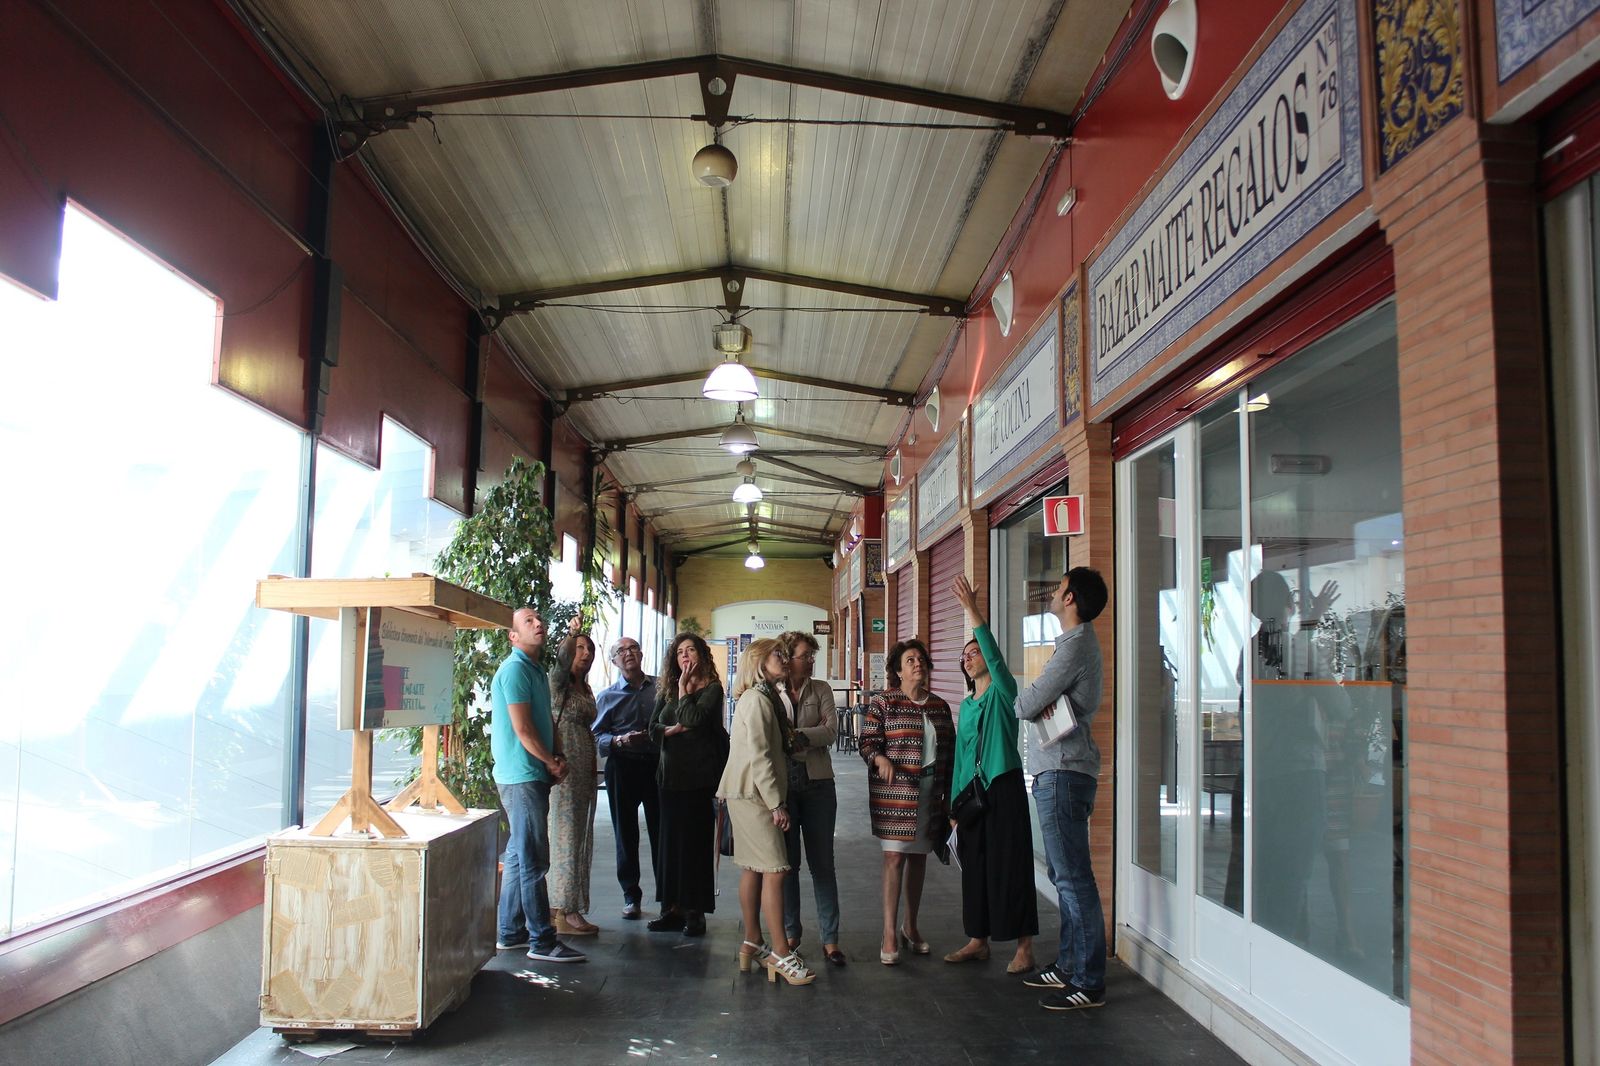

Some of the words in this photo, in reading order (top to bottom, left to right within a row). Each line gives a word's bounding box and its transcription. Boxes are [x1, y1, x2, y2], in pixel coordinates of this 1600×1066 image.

[1319, 71, 1338, 120] 78
[1098, 254, 1142, 359] BAZAR
[1143, 196, 1196, 320] MAITE
[1199, 64, 1310, 267] REGALOS
[1001, 377, 1031, 443] COCINA
